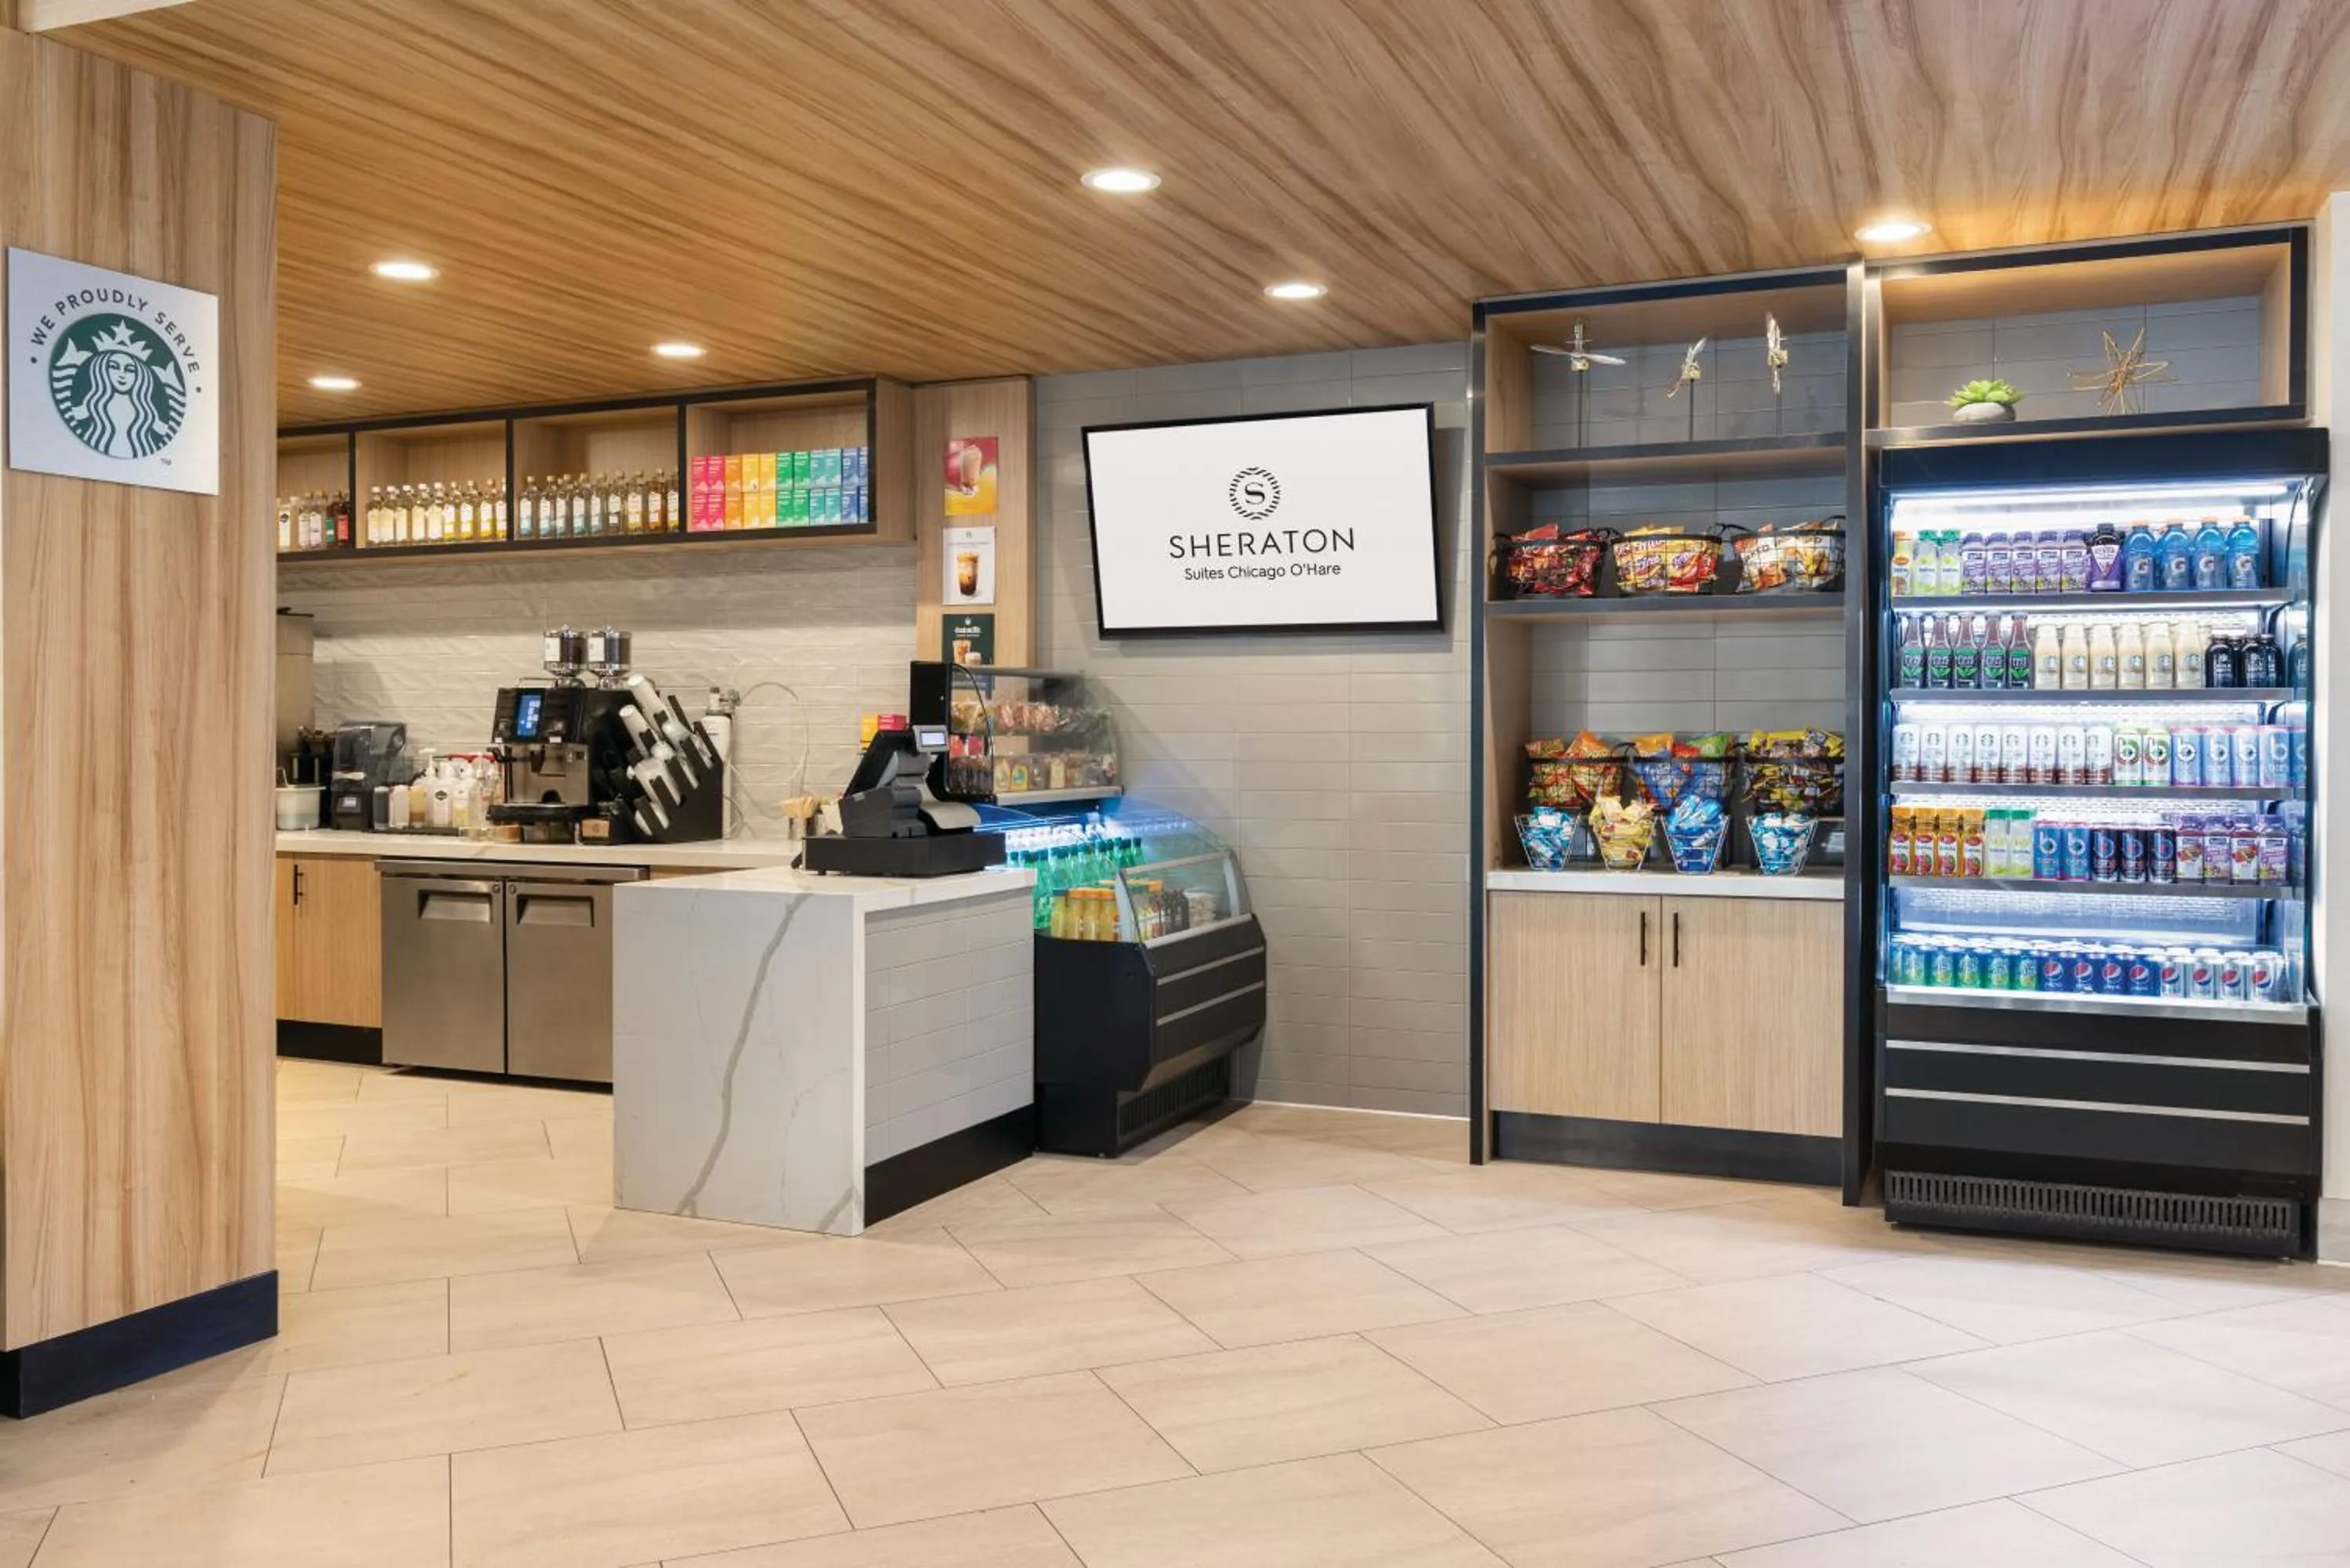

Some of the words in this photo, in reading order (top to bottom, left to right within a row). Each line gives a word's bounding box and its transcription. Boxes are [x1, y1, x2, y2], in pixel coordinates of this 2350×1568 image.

[31, 315, 55, 346] WE
[55, 287, 149, 315] PROUDLY
[154, 311, 200, 373] SERVE
[1244, 481, 1266, 505] S
[1170, 527, 1354, 559] SHERATON
[1184, 565, 1224, 580] Suites
[1227, 564, 1285, 580] Chicago
[1291, 562, 1342, 576] O'Hare
